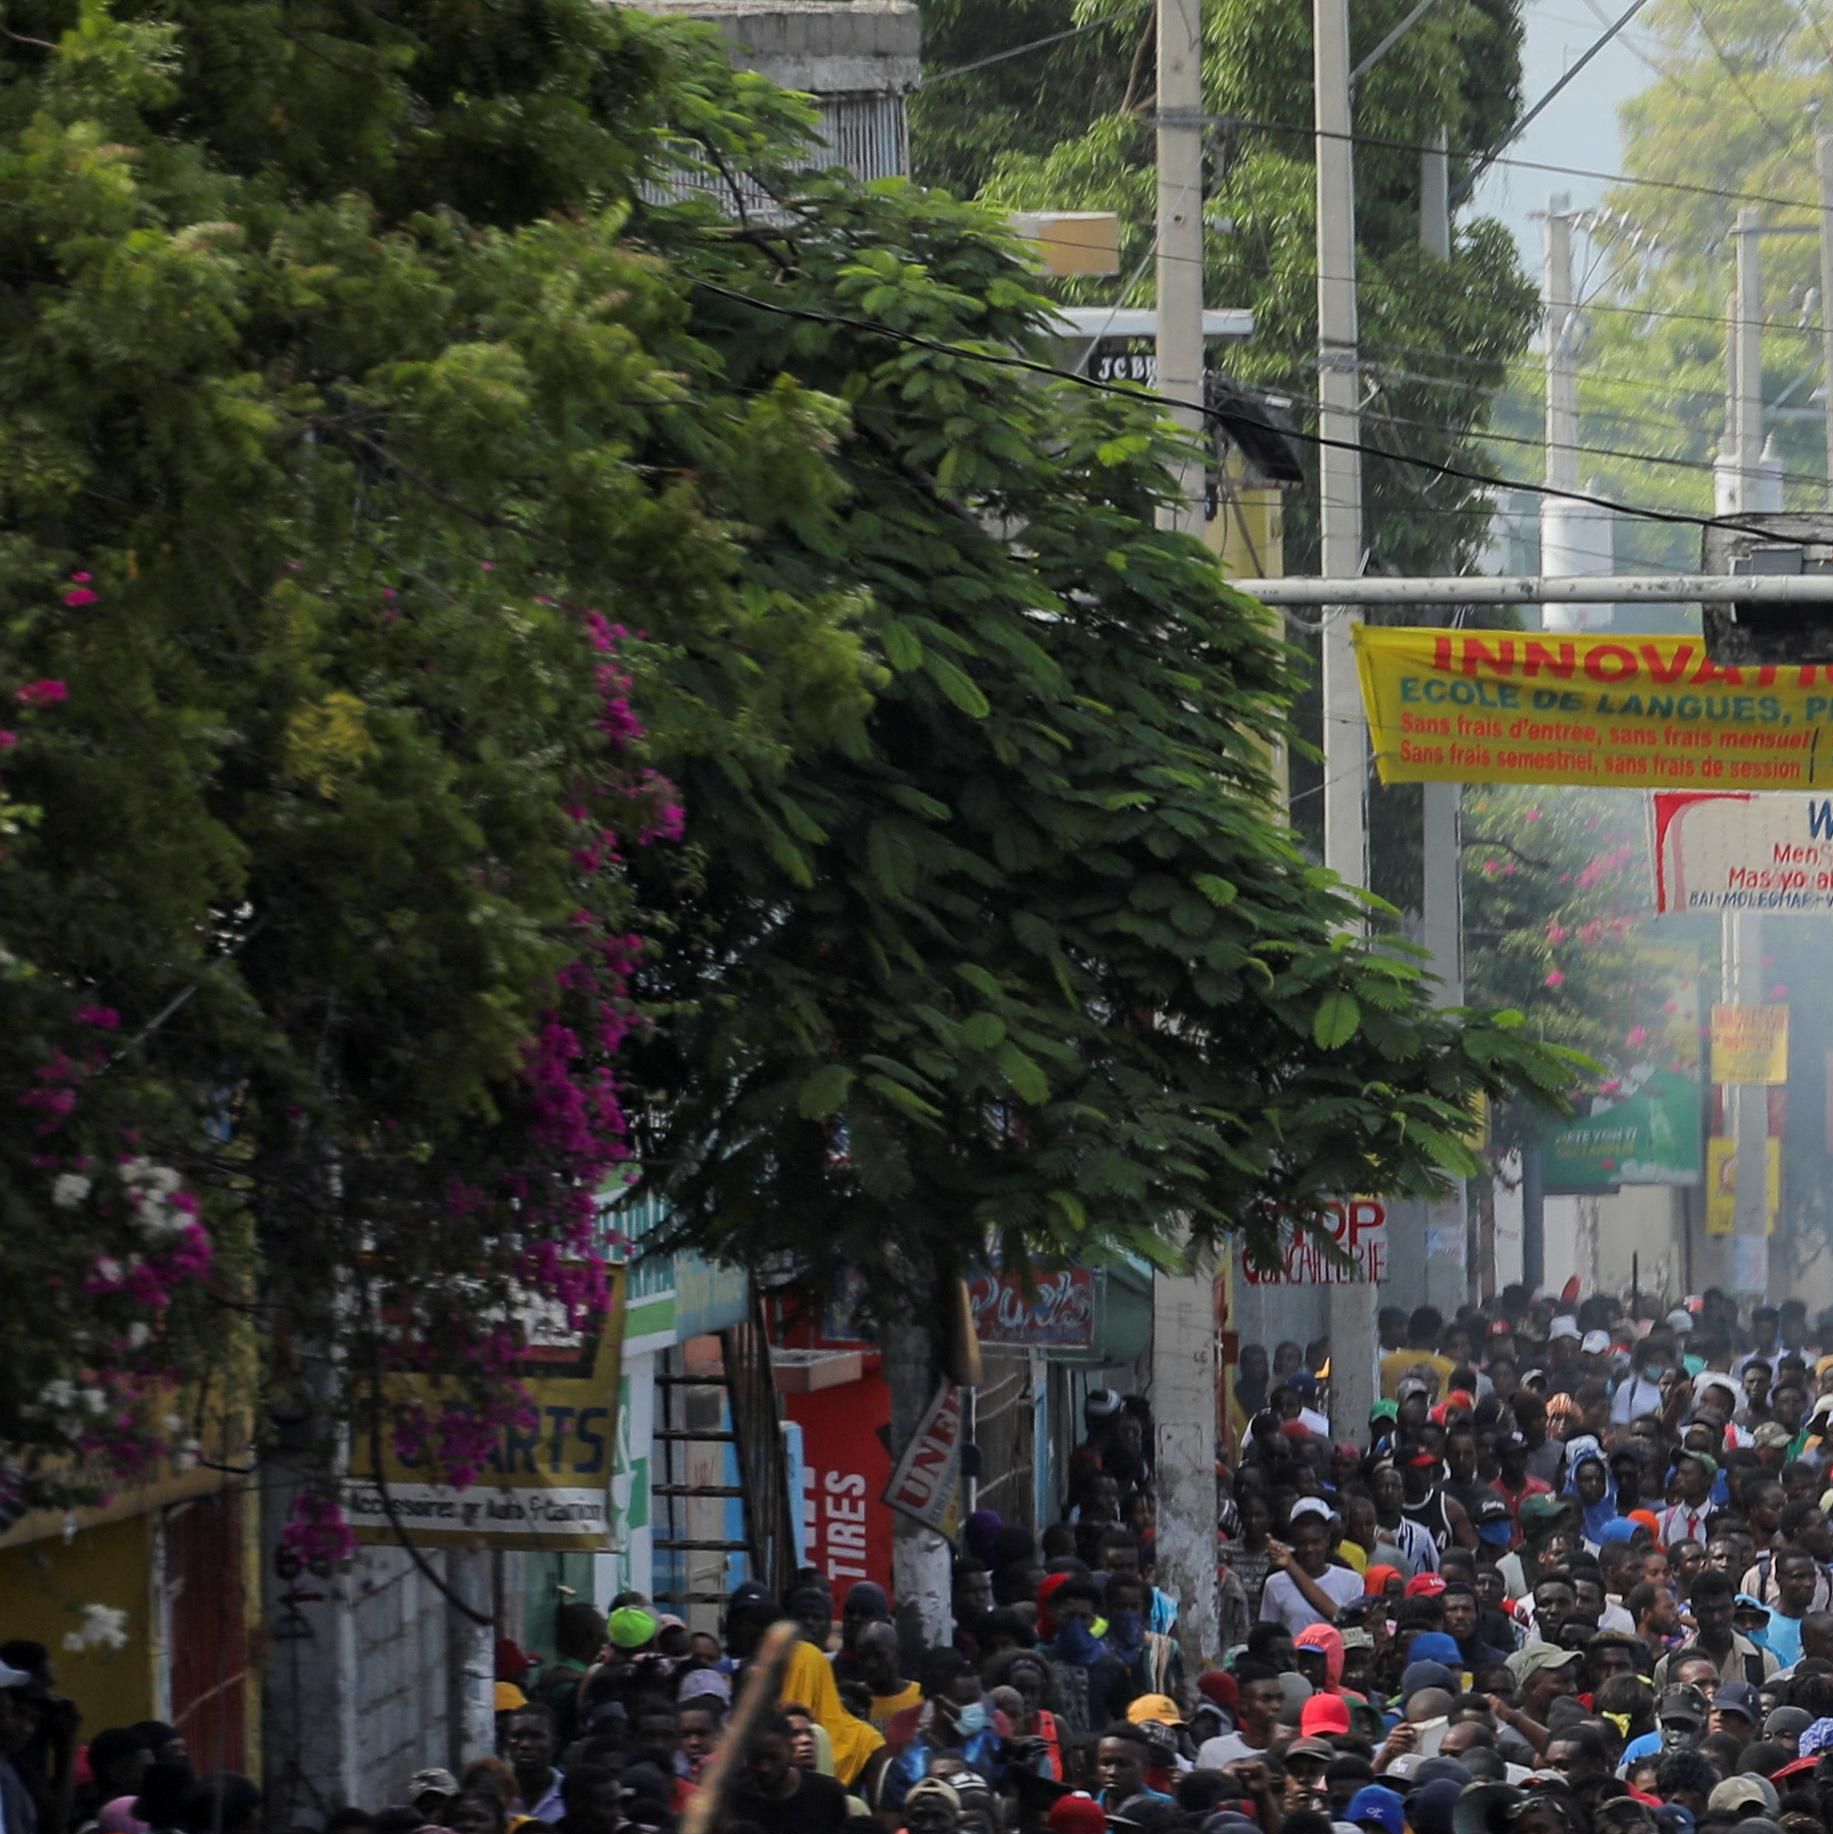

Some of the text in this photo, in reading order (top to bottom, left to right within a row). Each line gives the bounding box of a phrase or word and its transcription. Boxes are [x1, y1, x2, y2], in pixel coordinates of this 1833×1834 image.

[1400, 676, 1520, 709] ECOLE
[1532, 688, 1586, 712] DE
[1596, 692, 1792, 727] LANGUES,
[1401, 711, 1450, 736] Sans
[1457, 714, 1503, 739] frais
[1609, 727, 1657, 747] sans
[1663, 725, 1713, 748] frais
[1719, 726, 1811, 750] mensuel
[1401, 739, 1800, 780] Sans frais semestriel, sans frais de session
[823, 1470, 867, 1581] TIRES
